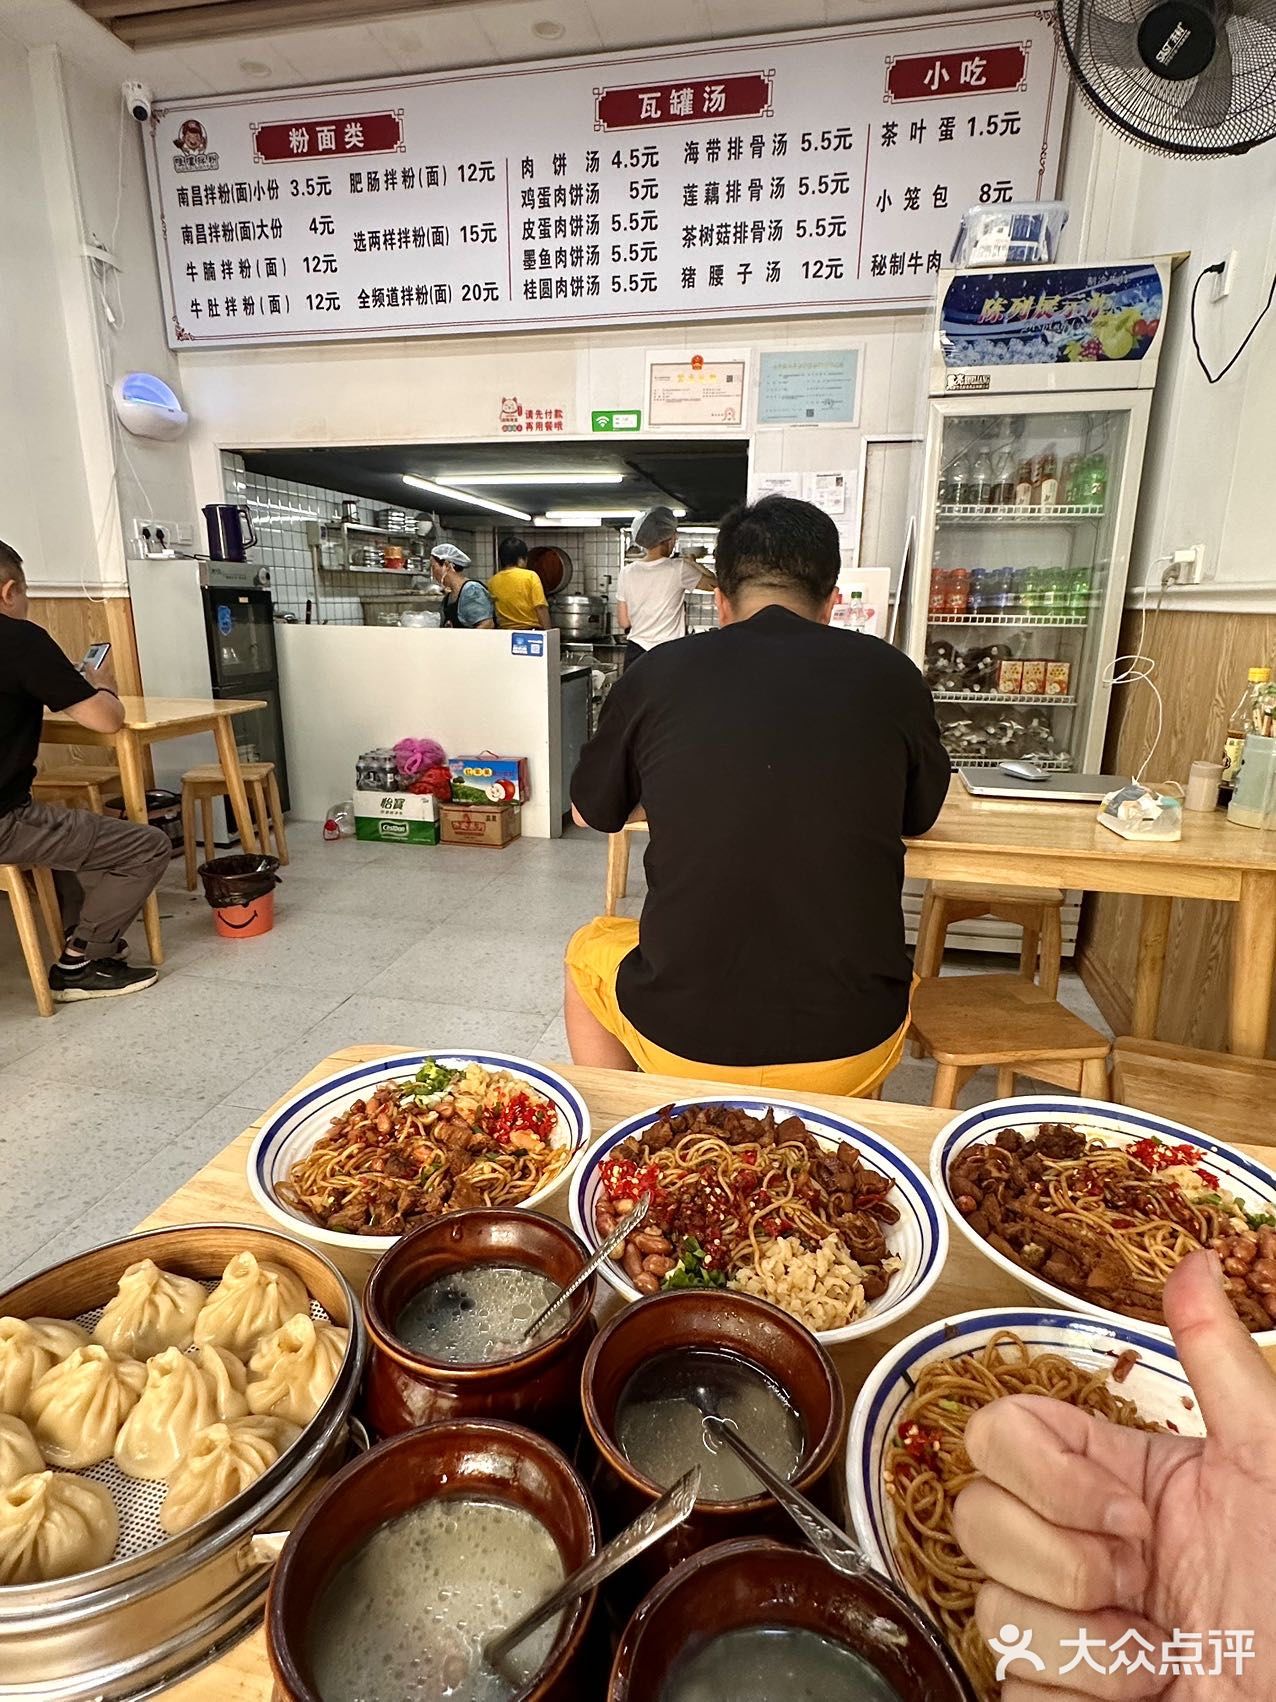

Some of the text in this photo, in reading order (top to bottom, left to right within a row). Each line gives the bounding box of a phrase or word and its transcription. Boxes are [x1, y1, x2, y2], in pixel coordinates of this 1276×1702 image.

[922, 56, 988, 91] 小吃
[637, 84, 727, 120] 瓦罐汤
[288, 121, 365, 154] 粉面类
[881, 110, 1022, 148] 茶叶蛋 1.5元
[684, 127, 853, 165] 海带排骨汤 5.5元
[349, 160, 496, 194] 肥肠拌粉(面) 12元
[521, 145, 660, 180] 肉饼汤 4.5元
[176, 175, 332, 208] 南昌拌粉(面)小份 3.5元
[520, 177, 659, 210] 鸡蛋肉饼汤 5元
[682, 171, 850, 207] 莲藕排骨汤 5.5元
[875, 180, 1014, 213] 小笼包 8元
[180, 215, 335, 245] 南昌拌粉(面)大份 4元
[353, 222, 498, 253] 选两样拌粉(面) 15元
[521, 209, 659, 241] 皮蛋肉饼汤 5.5元
[681, 215, 847, 249] 茶树菇排骨汤 5.5元
[186, 253, 338, 283] 牛腩拌粉(面) 12元
[522, 240, 658, 271] 墨鱼肉饼汤 5.5元
[870, 249, 942, 277] 秘制牛肉
[523, 271, 658, 300] 桂圆肉饼汤 5.5元
[681, 257, 844, 289] 猪腰子汤 12元
[190, 291, 341, 319] 牛肚拌粉(面) 12元
[357, 281, 500, 309] 全频道拌粉(面) 20元
[525, 409, 563, 419] 请先付款
[525, 421, 563, 431] 再用餐哦
